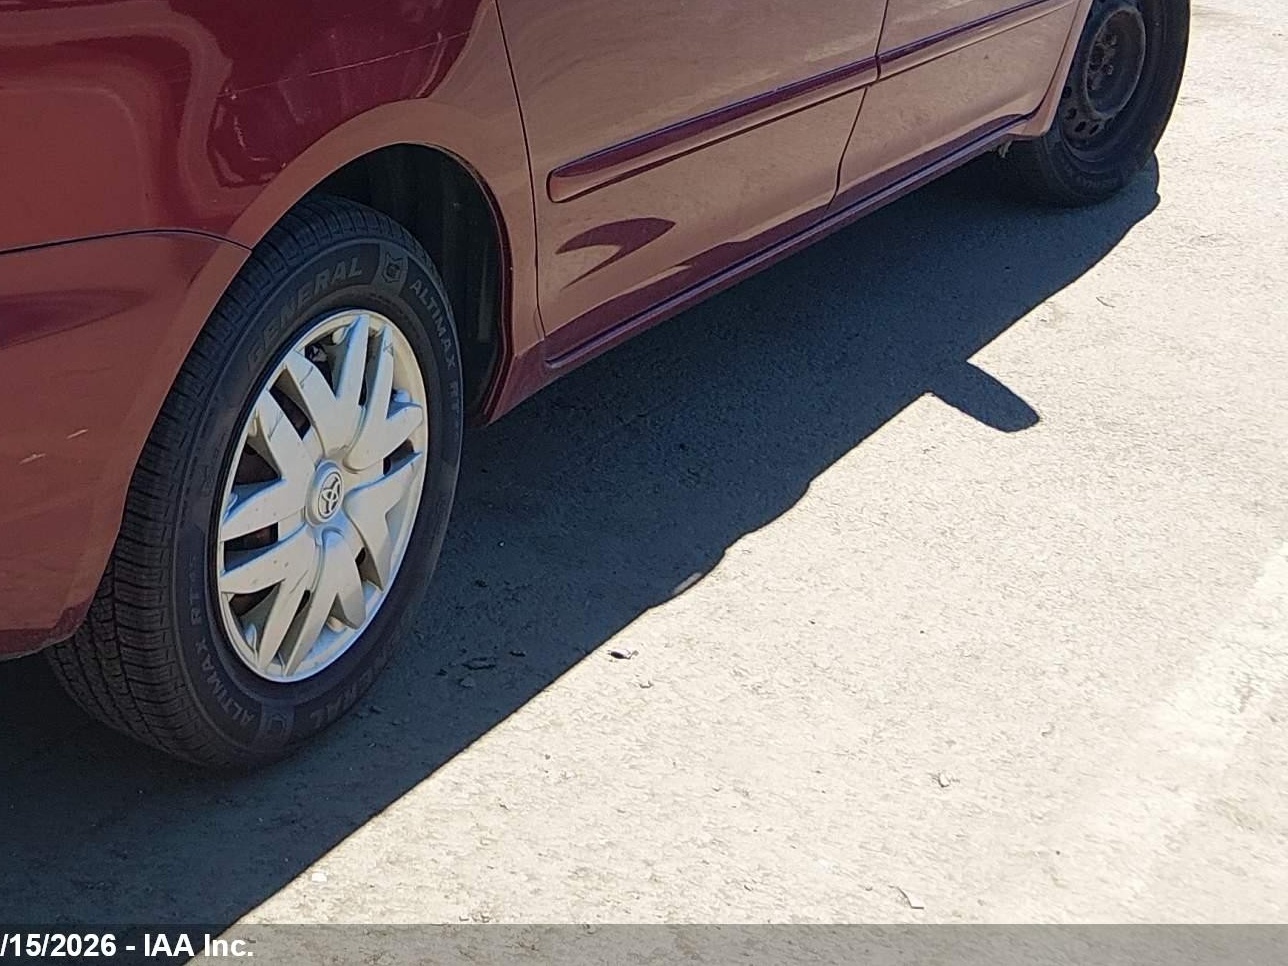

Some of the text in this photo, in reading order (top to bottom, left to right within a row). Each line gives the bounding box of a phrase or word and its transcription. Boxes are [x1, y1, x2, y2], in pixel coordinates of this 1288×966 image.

[246, 256, 364, 369] GENERAL
[410, 279, 456, 369] ALTIMAX
[195, 640, 256, 725] ALTIMAX
